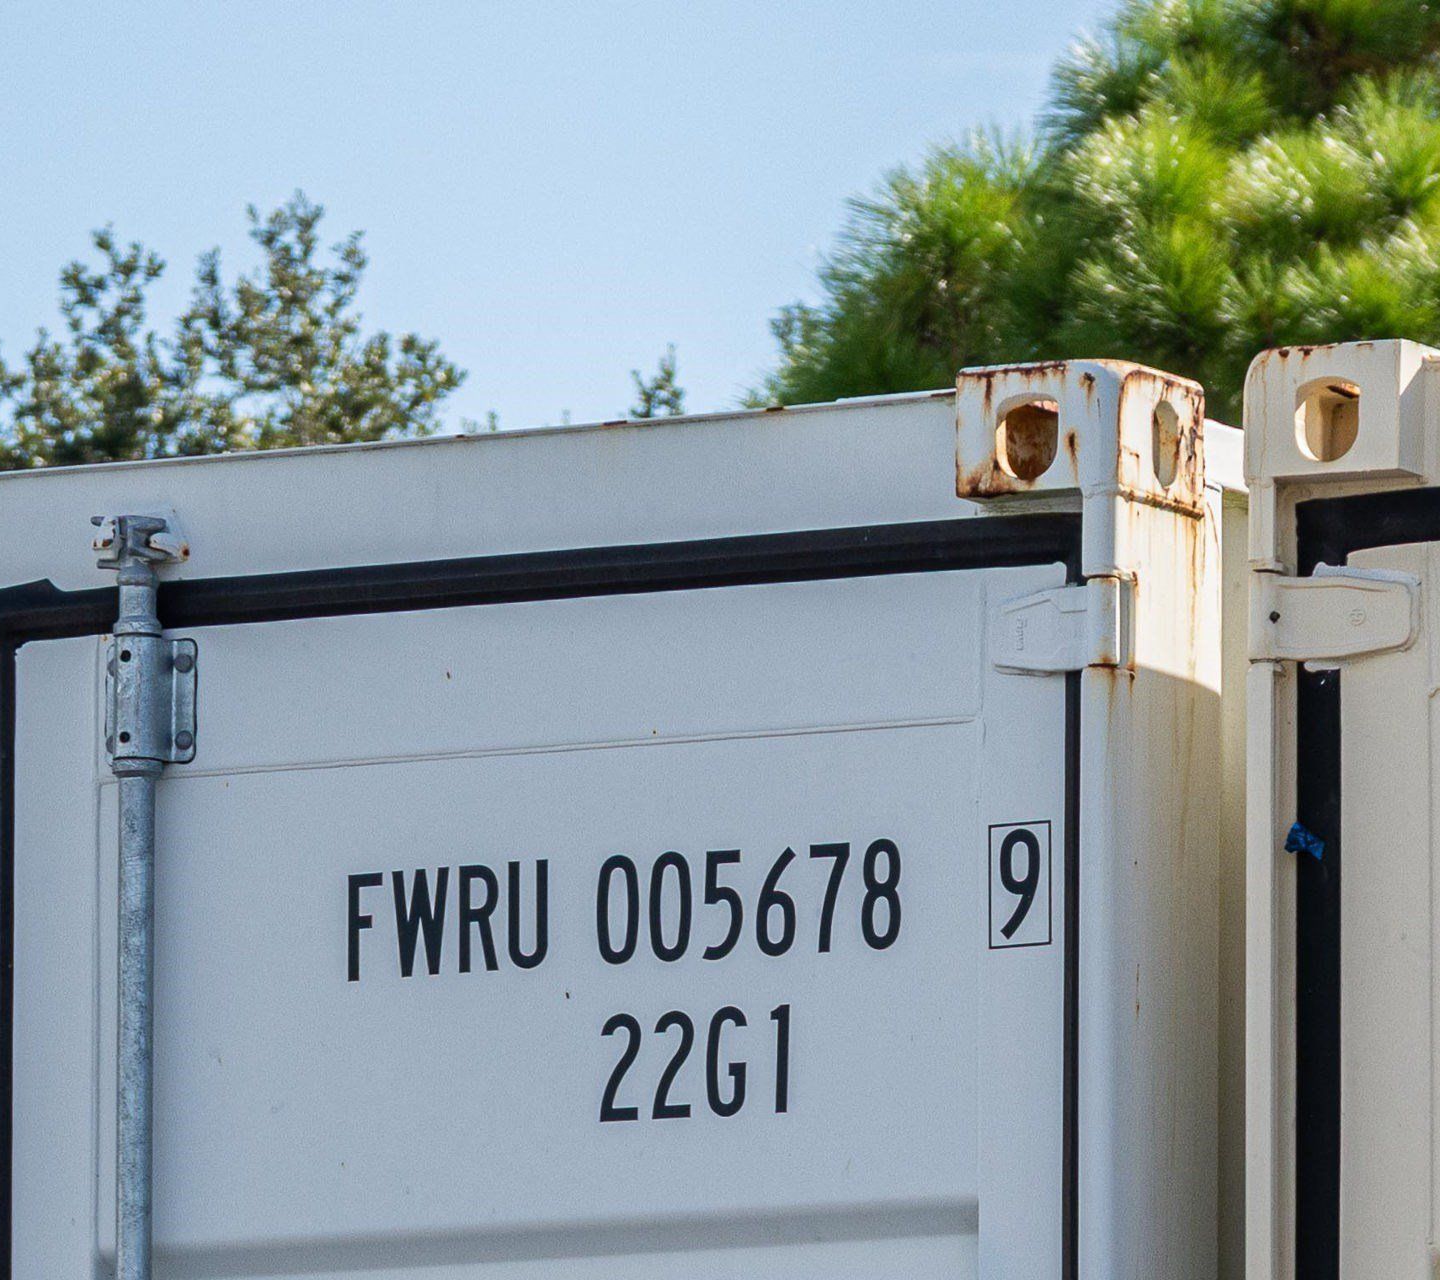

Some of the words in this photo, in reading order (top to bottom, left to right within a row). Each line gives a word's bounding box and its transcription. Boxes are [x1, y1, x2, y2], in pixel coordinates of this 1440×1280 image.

[348, 859, 549, 982] FWRU
[596, 838, 902, 965] 005678
[999, 827, 1042, 940] 9
[599, 1004, 790, 1123] 22G1
